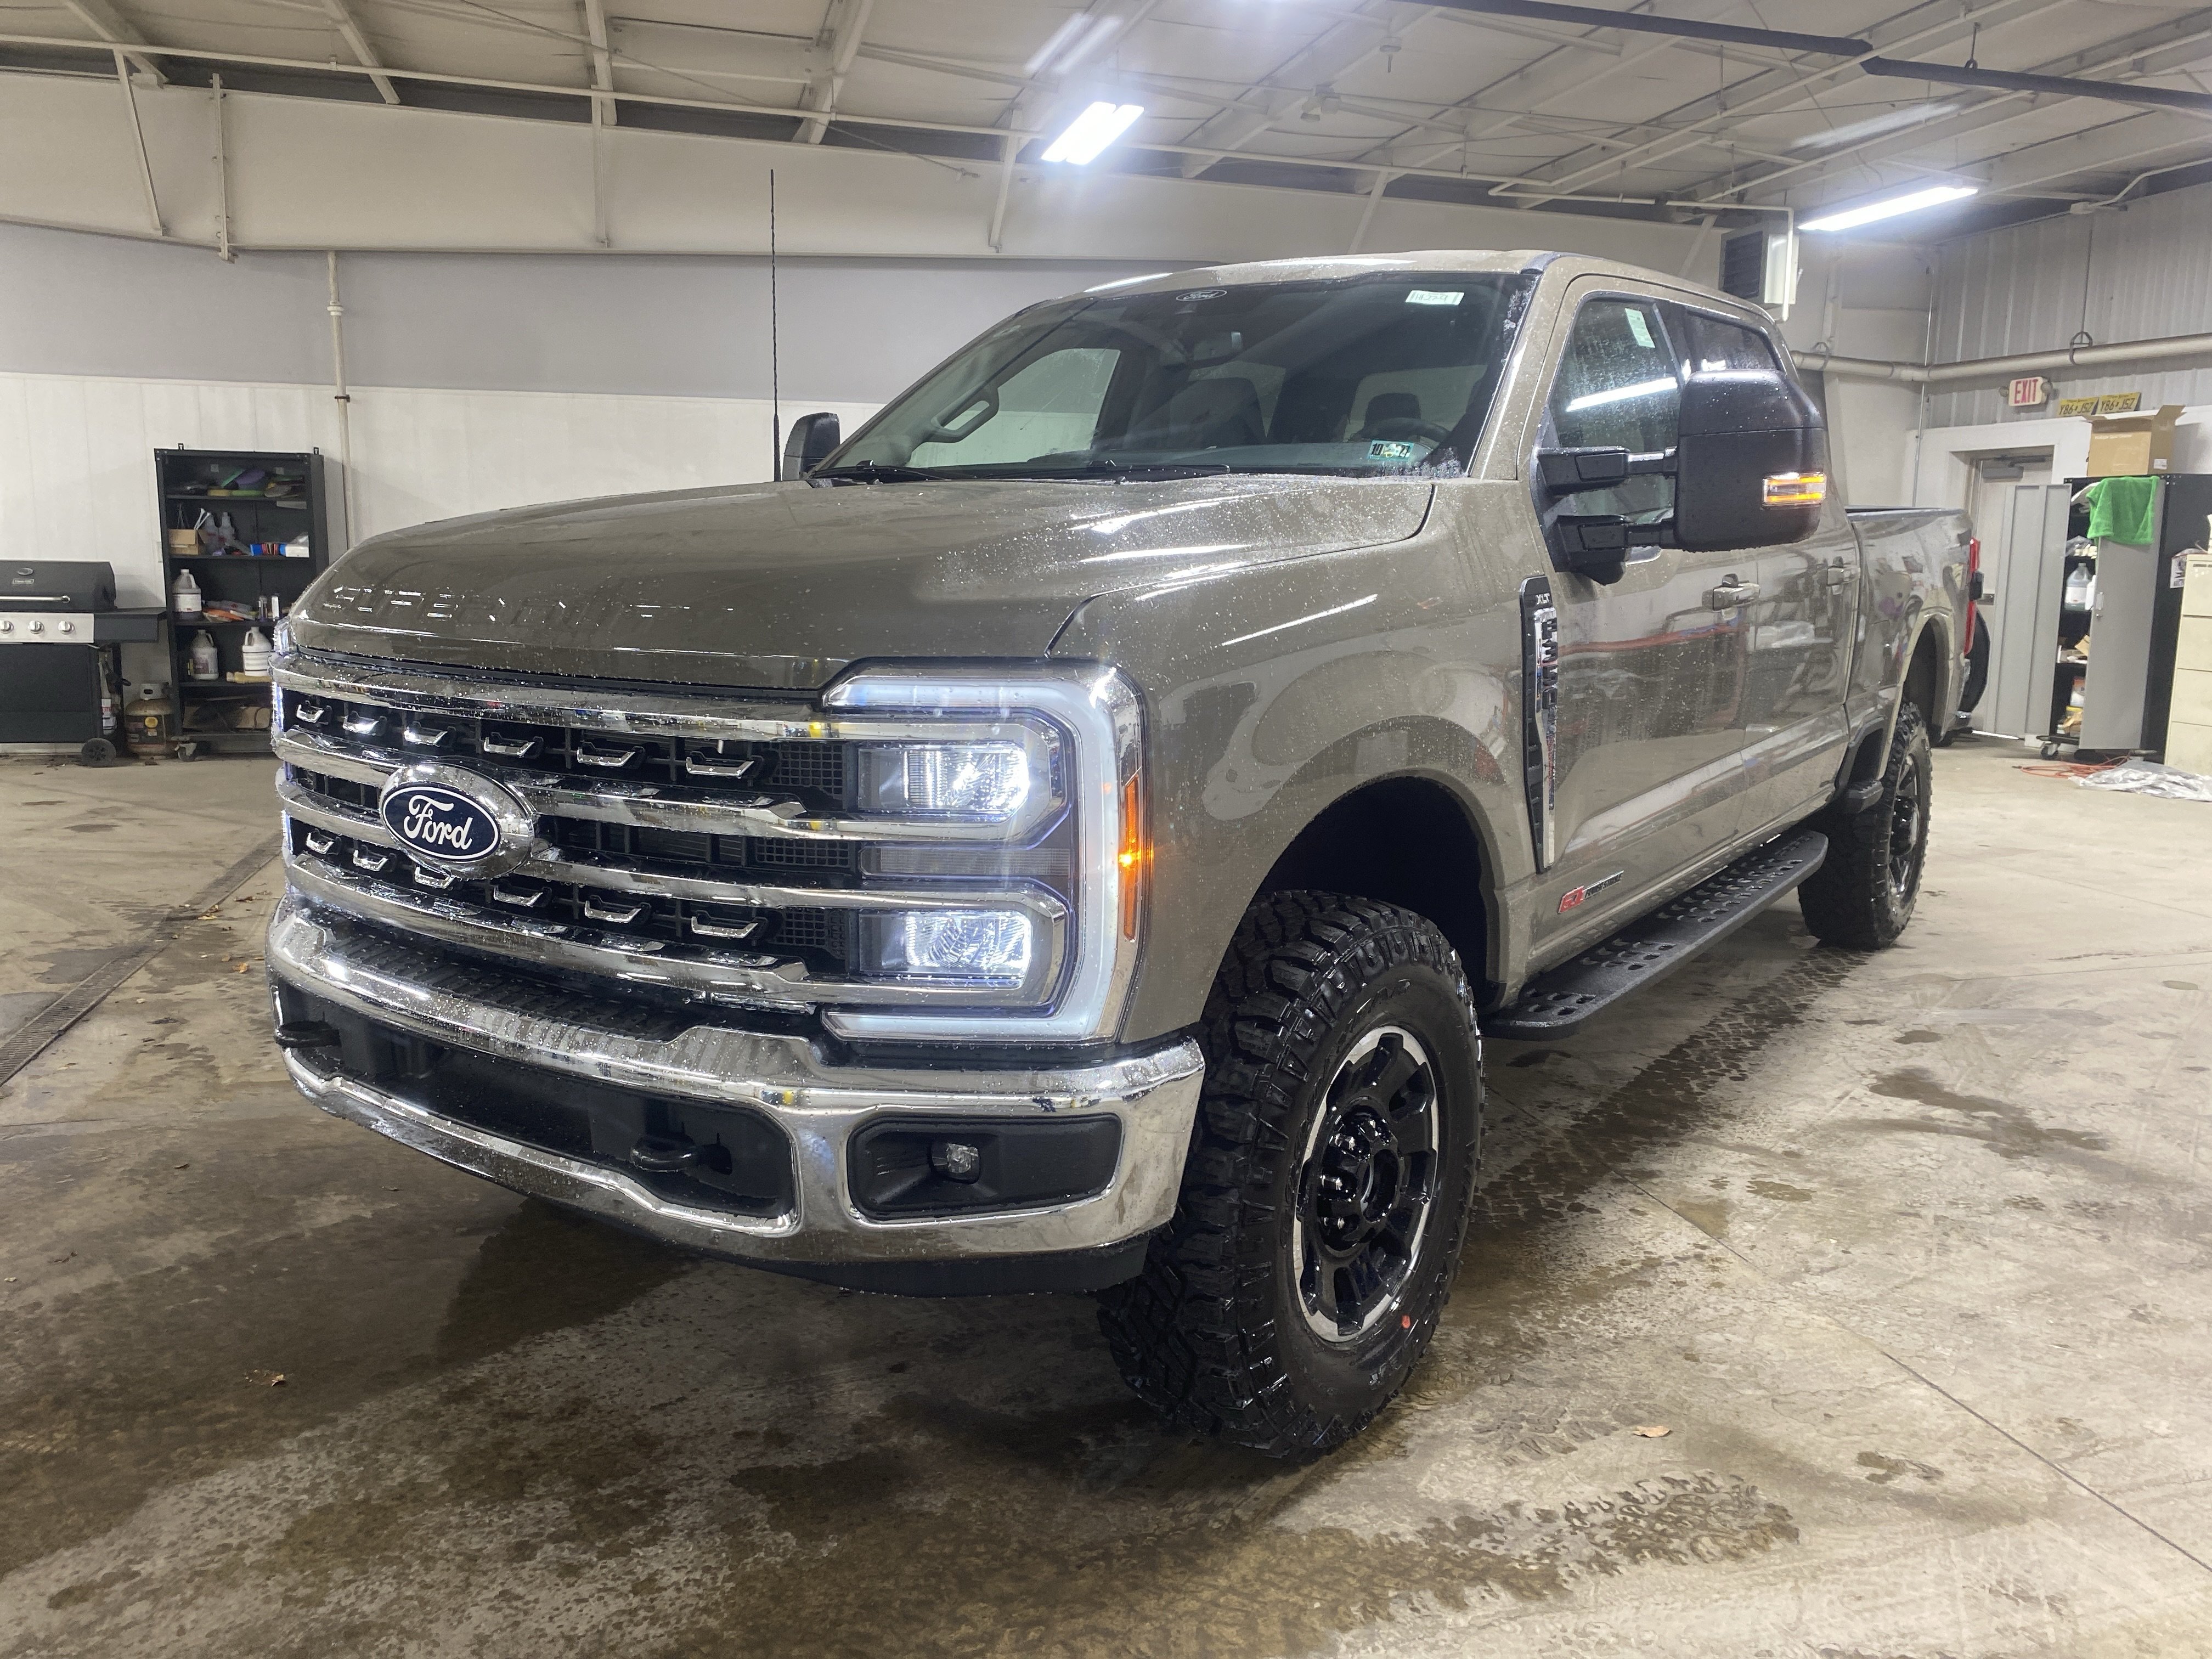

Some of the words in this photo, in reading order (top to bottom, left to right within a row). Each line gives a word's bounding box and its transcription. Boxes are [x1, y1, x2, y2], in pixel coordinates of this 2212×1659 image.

[2014, 379, 2039, 404] EXIT
[1371, 443, 1384, 455] 10
[1536, 592, 1550, 605] XLT
[403, 794, 474, 850] Ford
